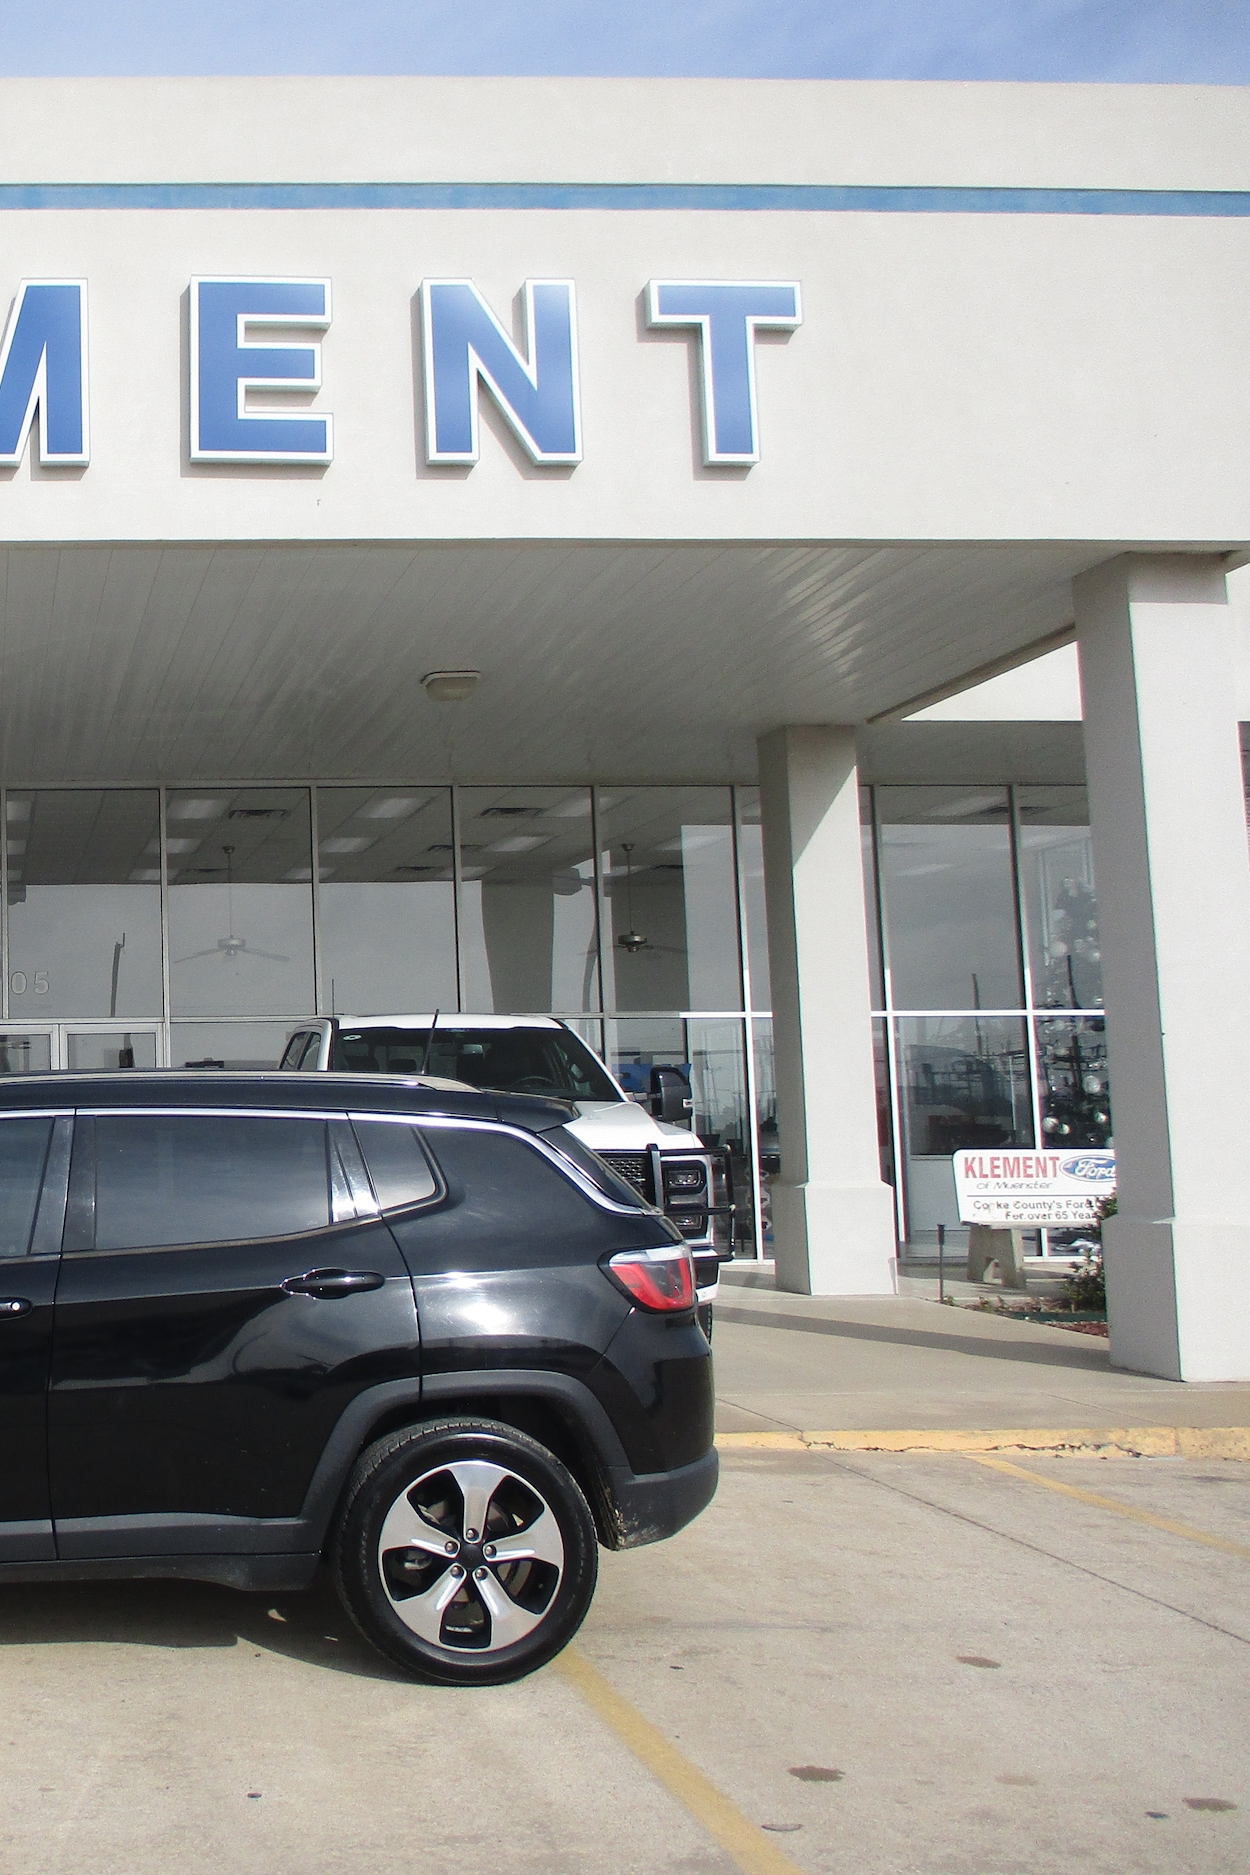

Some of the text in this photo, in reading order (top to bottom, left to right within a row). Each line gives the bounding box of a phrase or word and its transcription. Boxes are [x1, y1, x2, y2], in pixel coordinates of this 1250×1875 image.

[963, 1156, 1060, 1179] KLEMENT
[1027, 1212, 1052, 1220] over
[1055, 1210, 1069, 1220] 65
